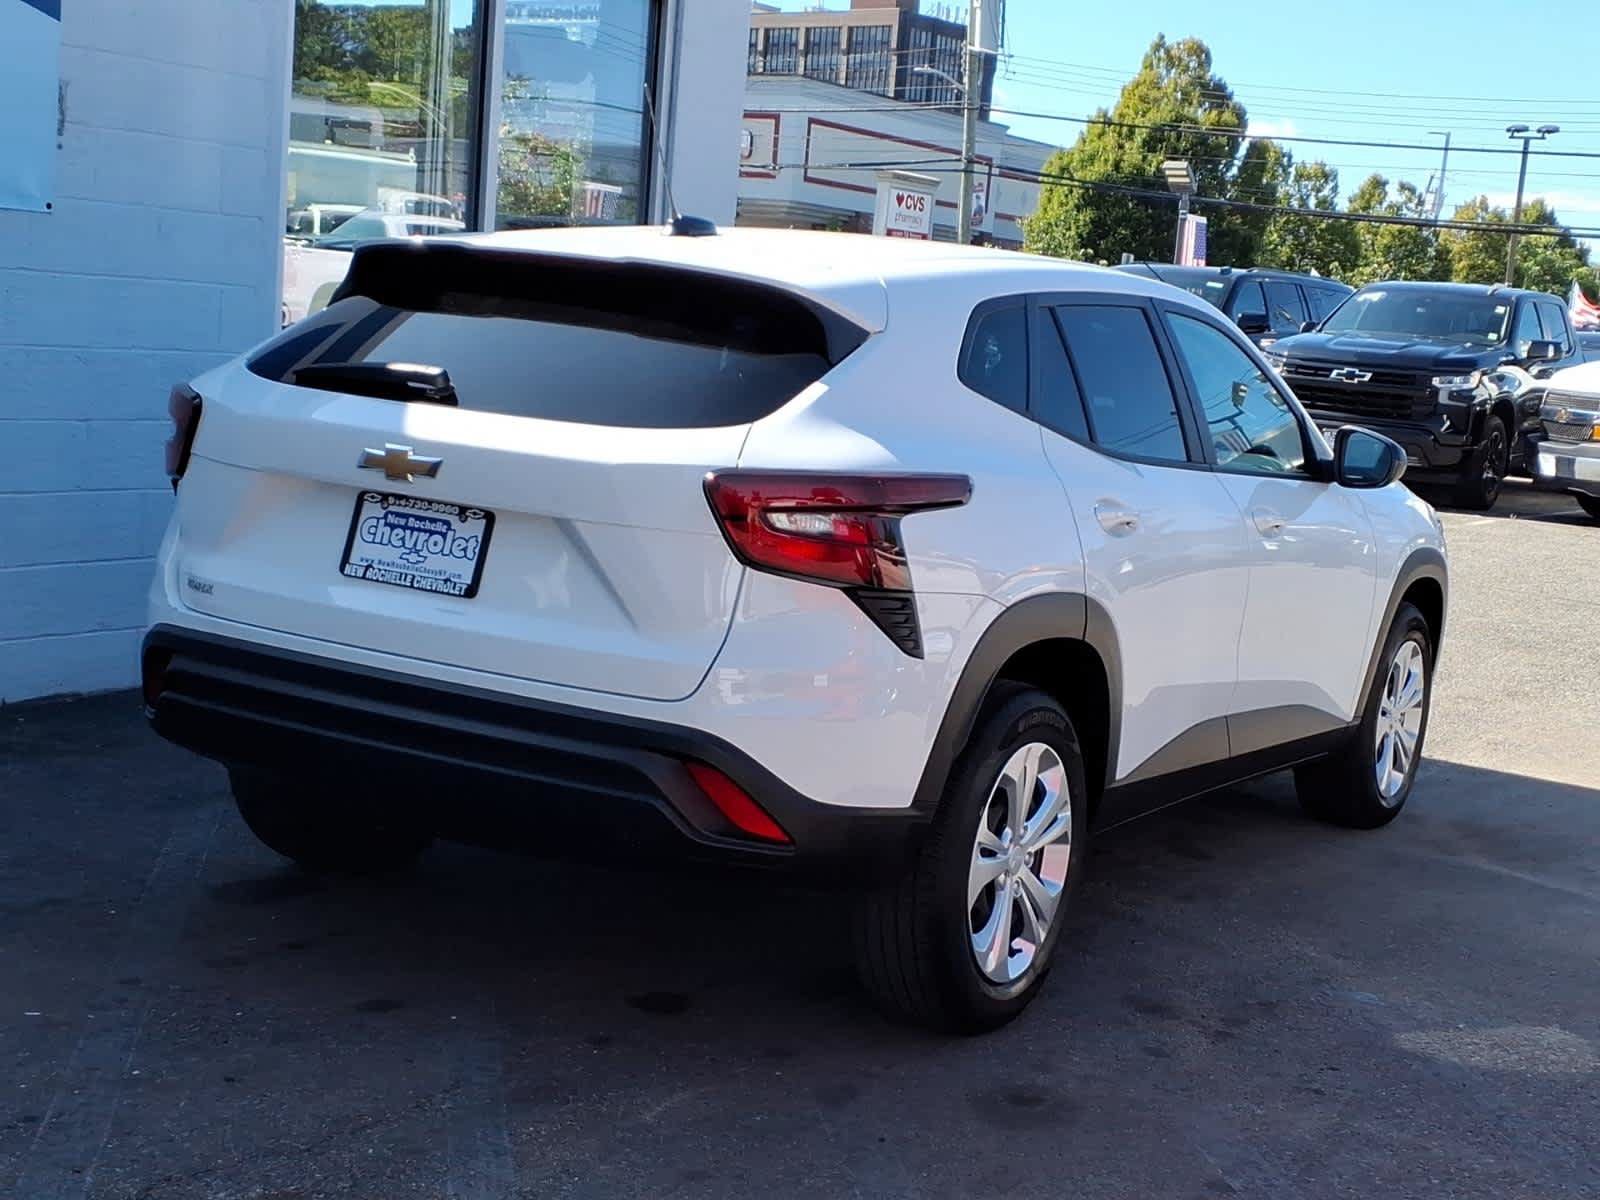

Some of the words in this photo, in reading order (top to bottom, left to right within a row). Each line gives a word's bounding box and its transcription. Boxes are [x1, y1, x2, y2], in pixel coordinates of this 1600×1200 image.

[905, 194, 925, 212] CVS
[387, 513, 407, 525] New
[407, 517, 448, 533] Rochelle
[360, 516, 480, 560] Chevrolet
[344, 563, 365, 577] NEW
[365, 567, 413, 585] ROCHELLE
[413, 577, 468, 596] CHEVROLET
